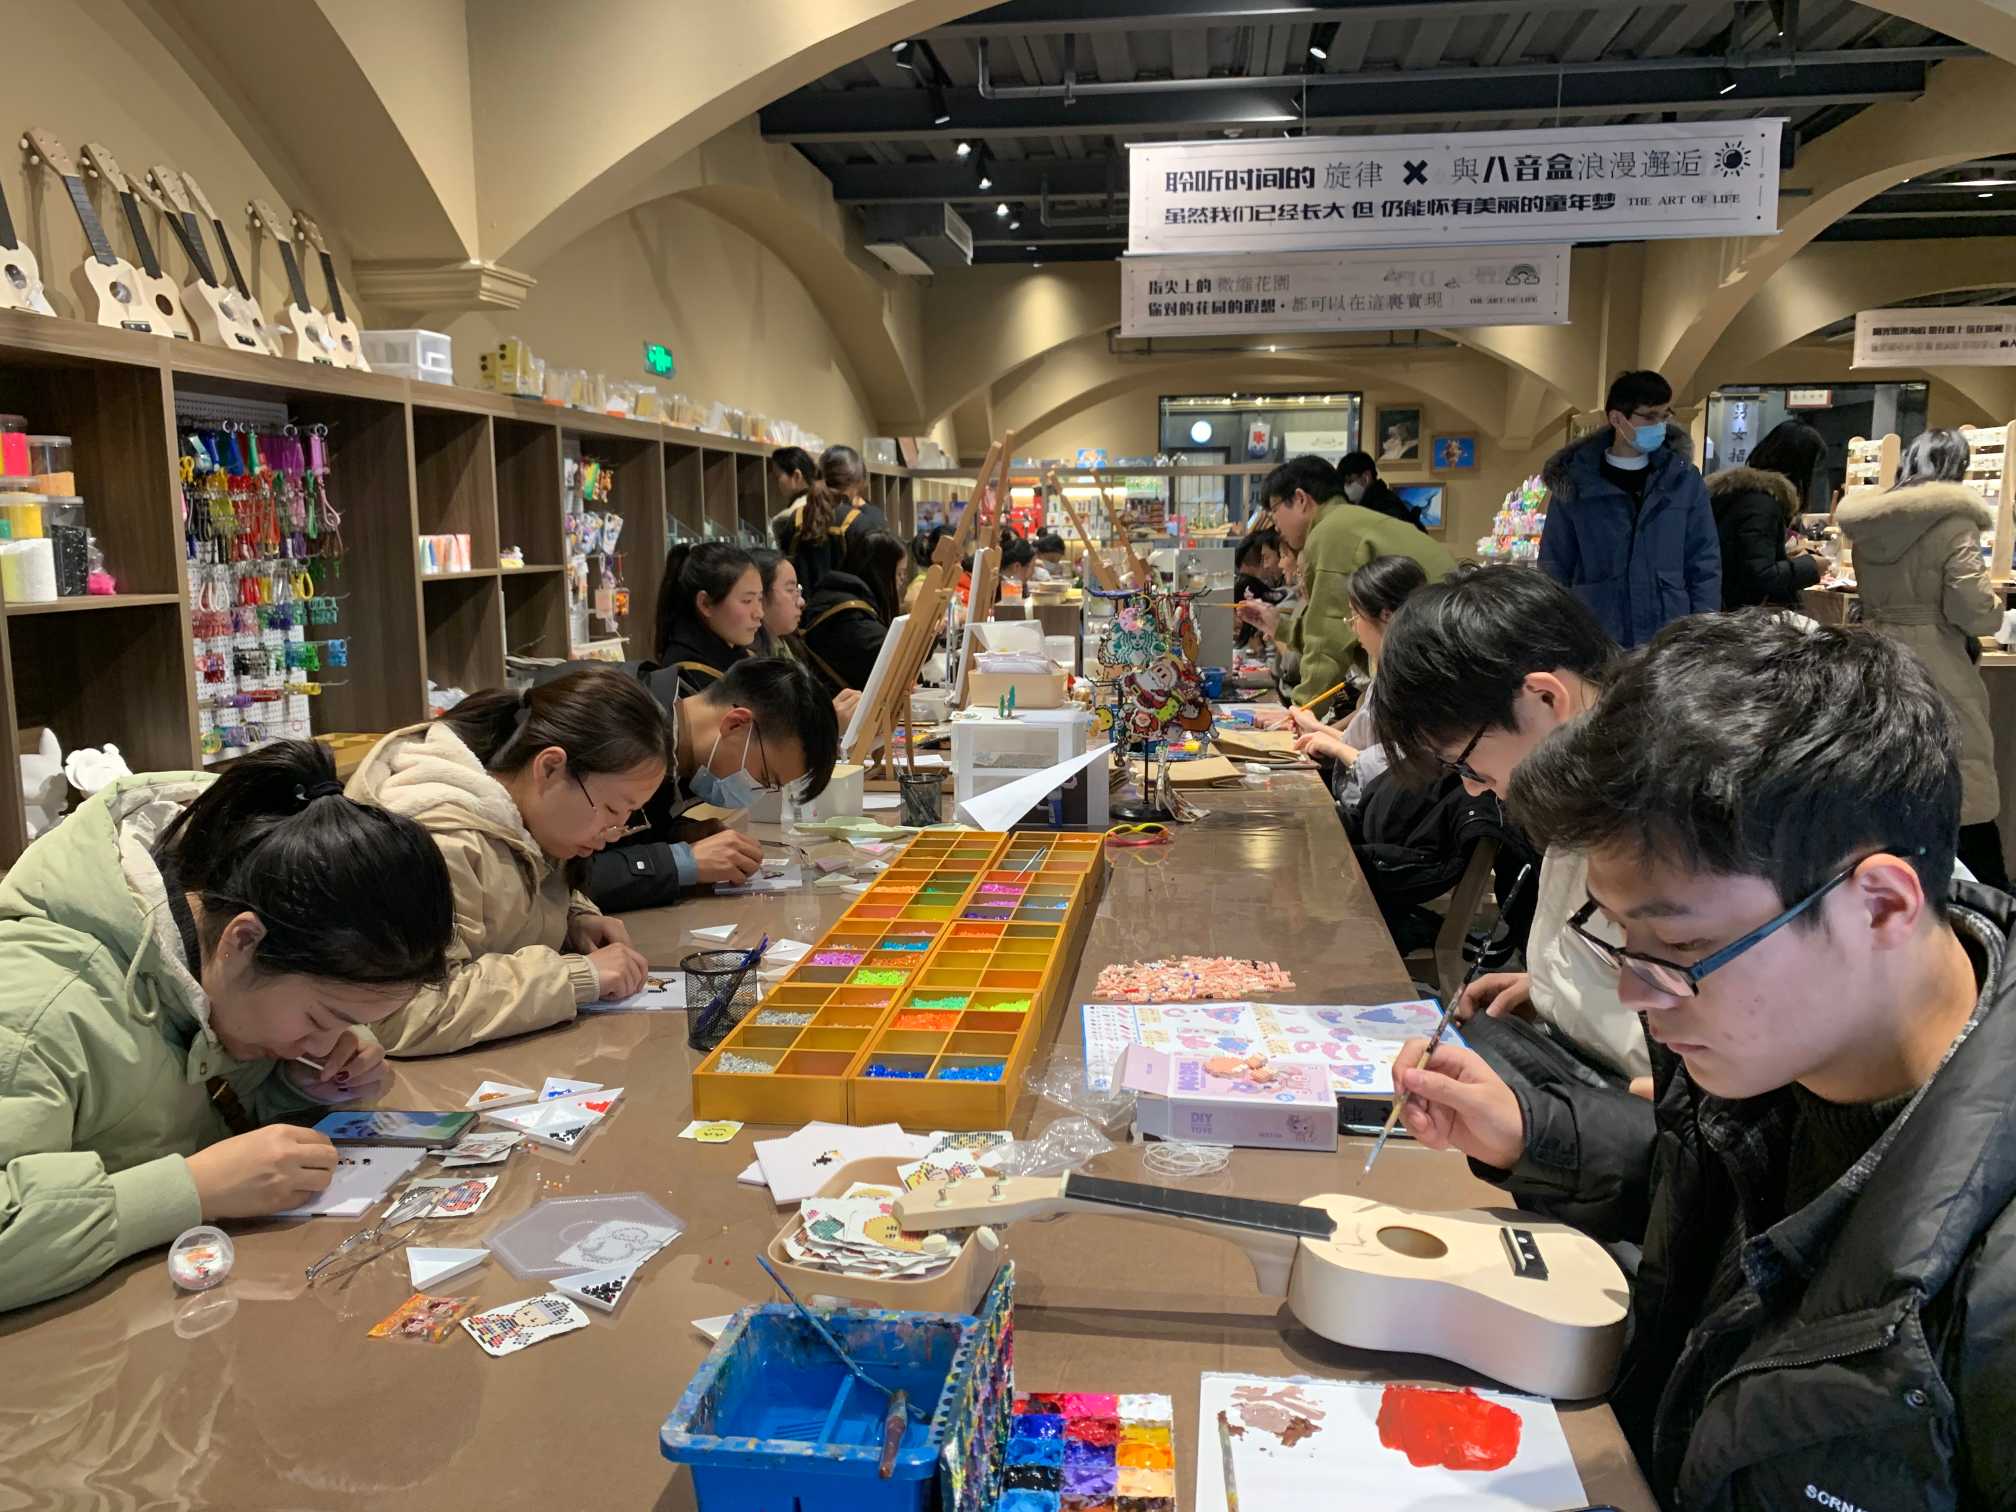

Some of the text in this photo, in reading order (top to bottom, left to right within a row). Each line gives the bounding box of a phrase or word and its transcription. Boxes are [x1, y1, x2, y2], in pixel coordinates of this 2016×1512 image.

[1165, 167, 1315, 193] 聆听时间的
[1323, 160, 1383, 189] 旋律
[1451, 149, 1703, 184] 與八音盒浪漫邂逅
[1164, 202, 1345, 225] 虽然我们已经长大
[1352, 201, 1374, 219] 但
[1628, 196, 1651, 207] THE
[1657, 195, 1687, 206] ART
[1691, 194, 1708, 205] OF
[1713, 193, 1741, 204] LIFE
[1149, 278, 1211, 295] 指尖上的
[1190, 1112, 1213, 1123] DIY
[1804, 1484, 1868, 1512] SCRN
